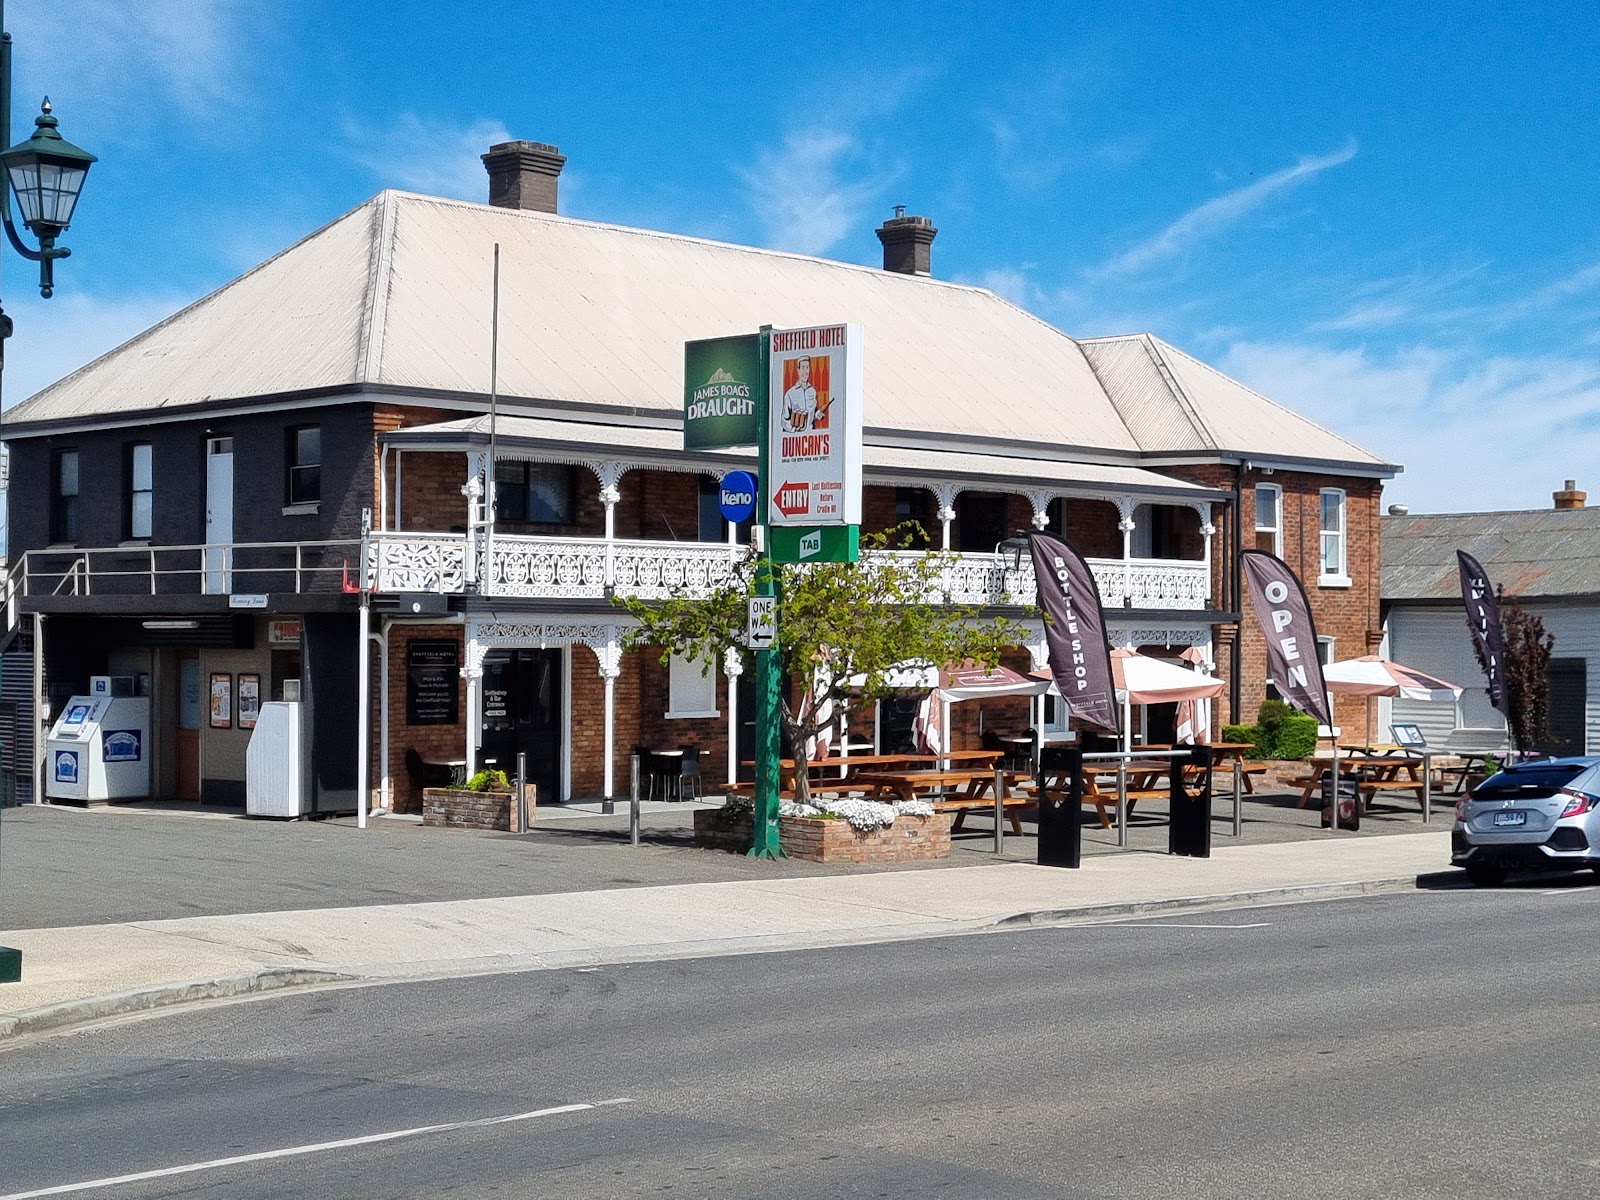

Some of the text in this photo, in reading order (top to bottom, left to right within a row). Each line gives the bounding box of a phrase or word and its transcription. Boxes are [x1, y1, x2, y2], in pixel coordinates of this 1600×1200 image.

[773, 326, 845, 352] SHEFFIELD HOTEL
[693, 384, 750, 404] JAMES BOAG'S
[688, 398, 755, 420] DRAUGHT
[782, 434, 830, 457] DUNCAN'S
[781, 490, 808, 509] ENTRY
[802, 539, 819, 551] TAB
[753, 601, 771, 613] ONE
[751, 617, 772, 629] WA
[1054, 556, 1088, 691] BOTTLE SHOP
[1265, 580, 1308, 689] OPEN
